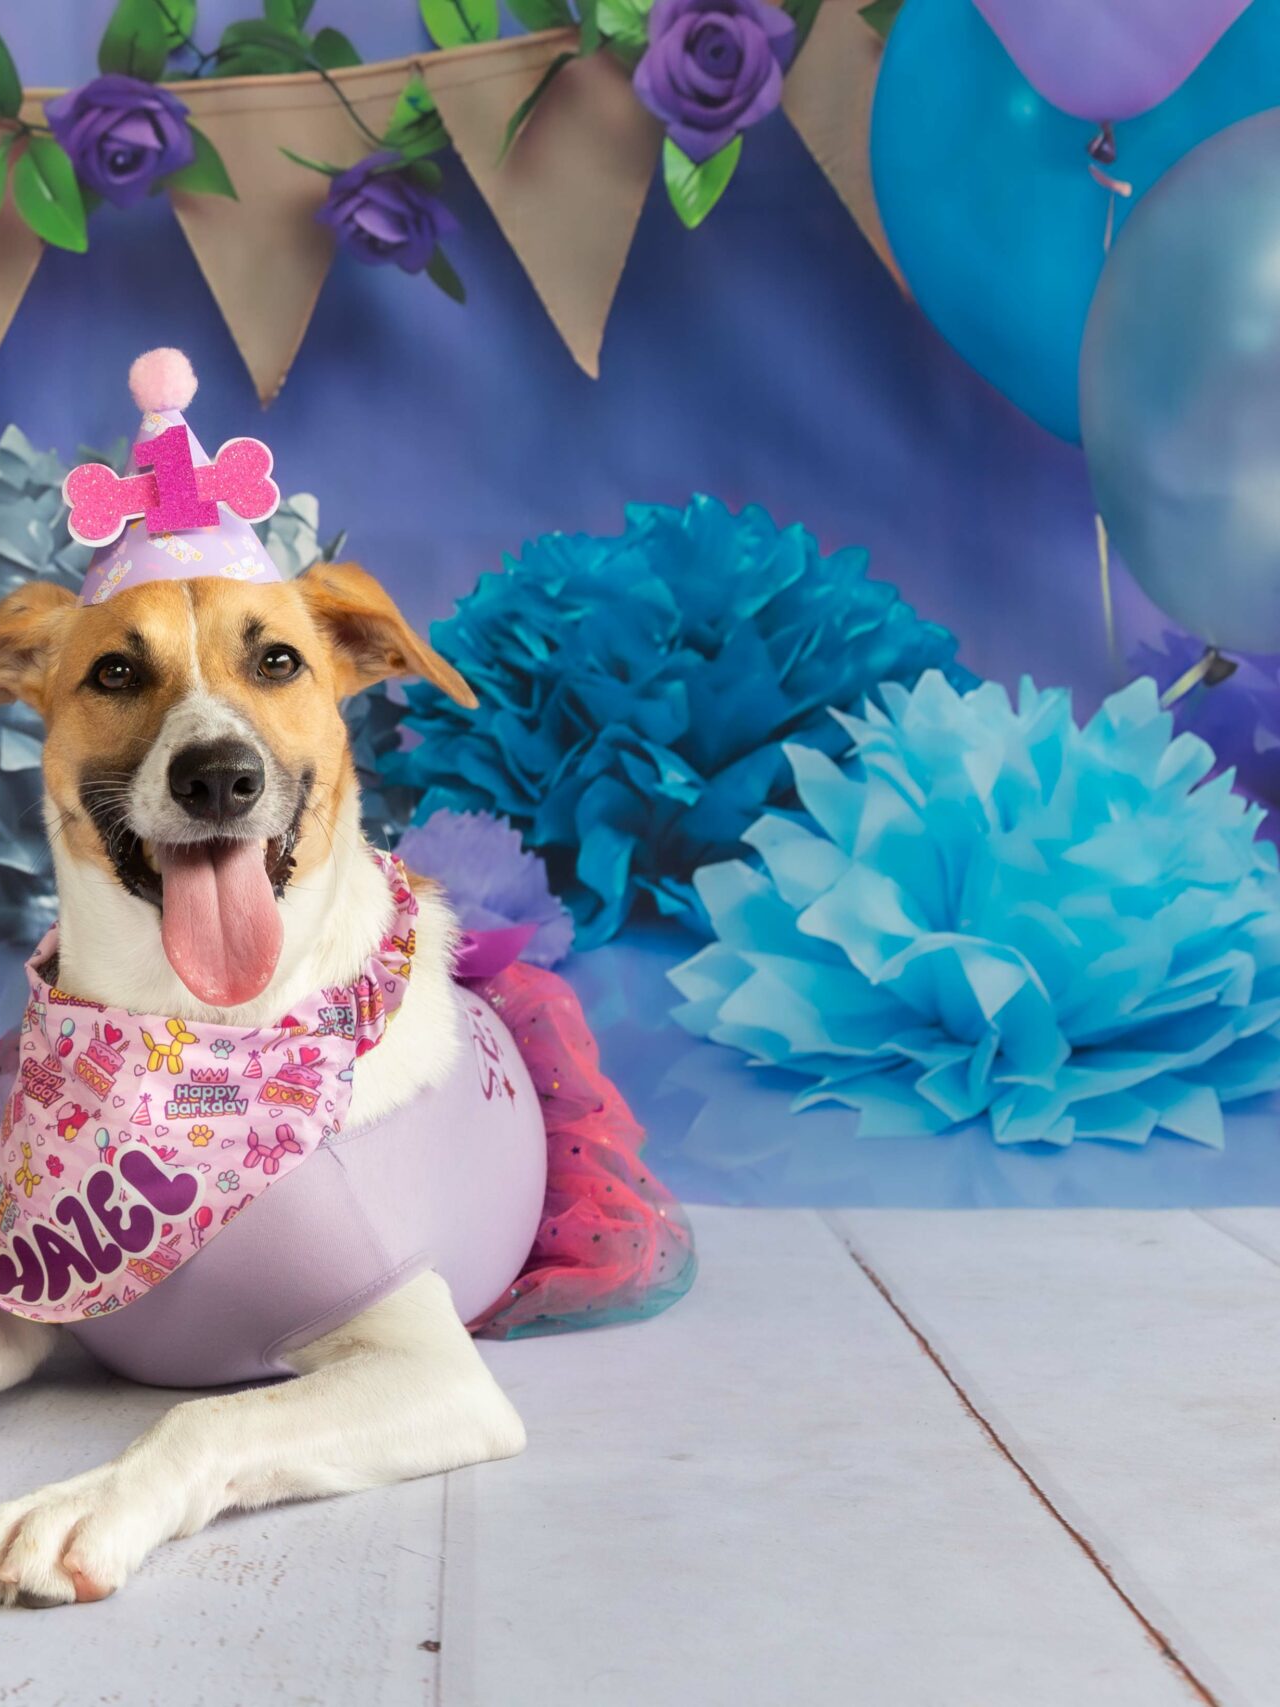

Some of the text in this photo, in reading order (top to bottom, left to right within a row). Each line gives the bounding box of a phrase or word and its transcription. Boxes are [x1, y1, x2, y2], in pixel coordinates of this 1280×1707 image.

[133, 423, 220, 533] 1
[22, 1057, 66, 1090] Happy
[174, 1084, 240, 1102] Happy
[165, 1099, 249, 1119] Barkday
